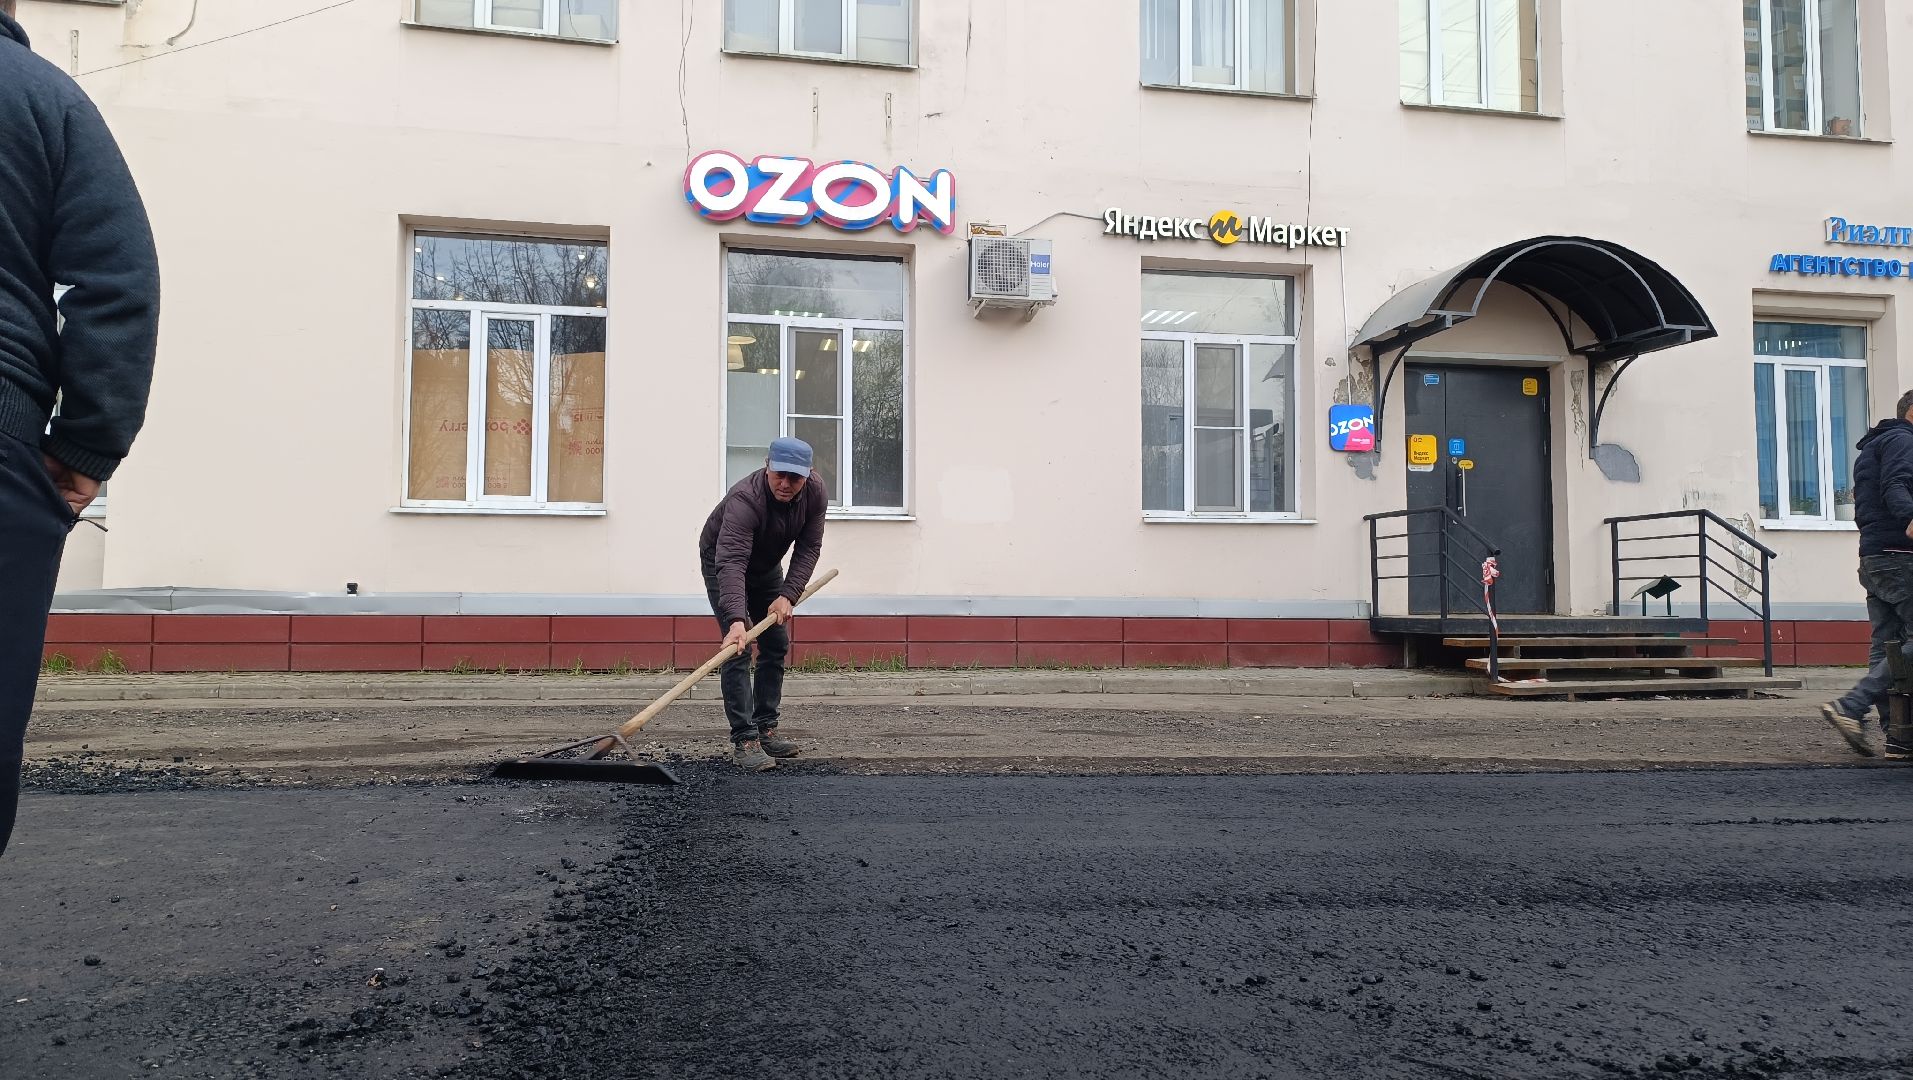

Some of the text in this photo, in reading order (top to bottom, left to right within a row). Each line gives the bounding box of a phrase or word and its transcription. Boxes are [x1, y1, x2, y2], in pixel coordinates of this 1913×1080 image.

[687, 152, 953, 229] OZON
[1103, 207, 1203, 241] Яндекс
[1249, 216, 1350, 248] Маркет
[1825, 217, 1913, 245] Риэлт
[1770, 254, 1901, 276] АГЕНТСТВО
[1331, 415, 1374, 436] OZON
